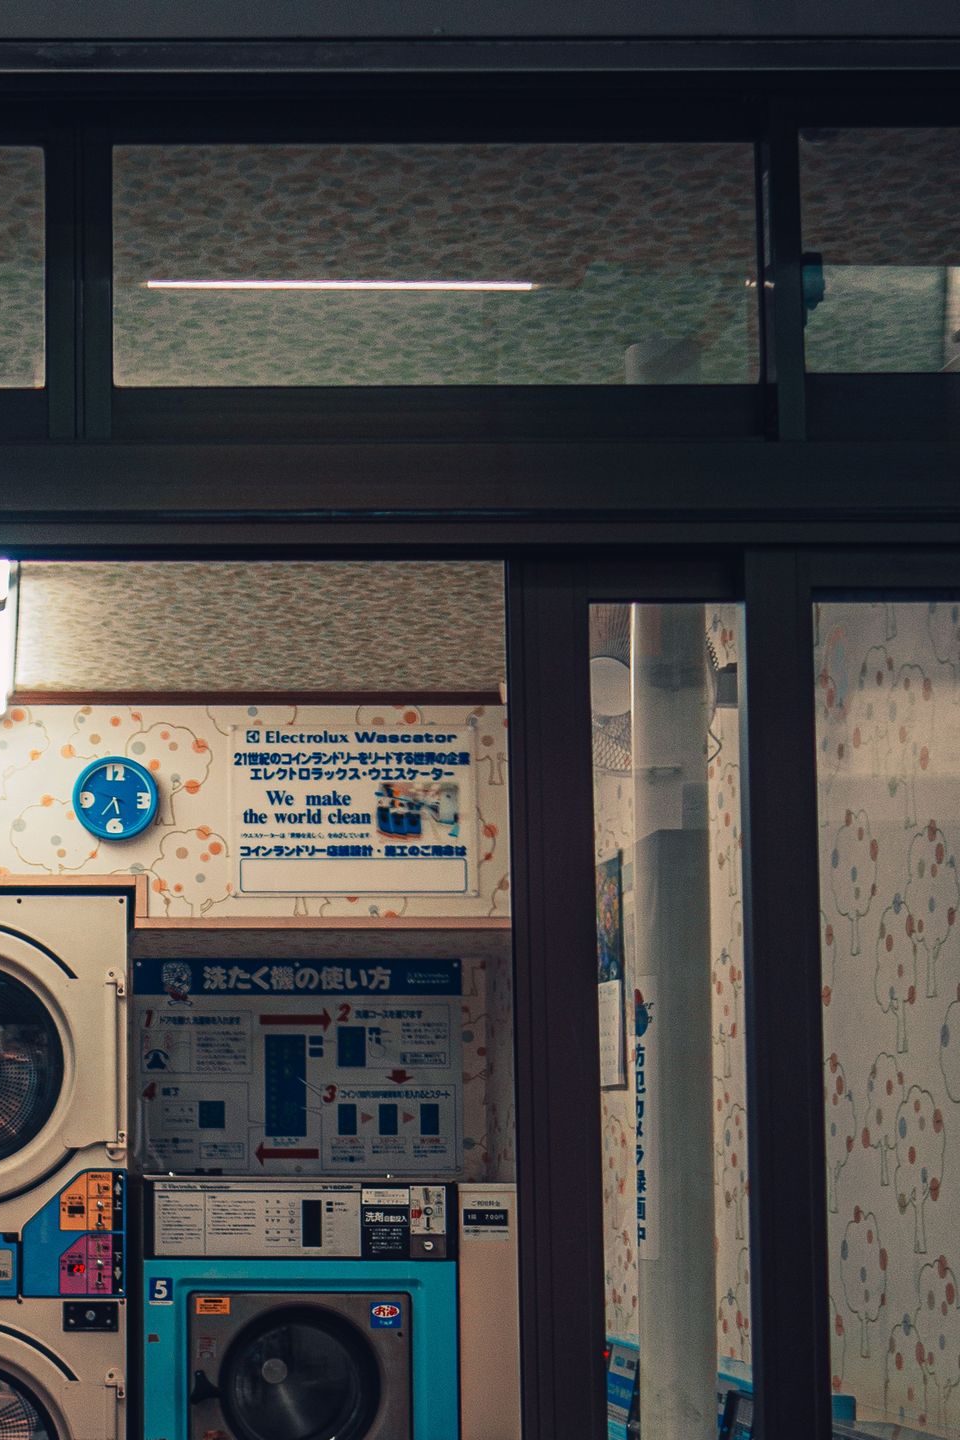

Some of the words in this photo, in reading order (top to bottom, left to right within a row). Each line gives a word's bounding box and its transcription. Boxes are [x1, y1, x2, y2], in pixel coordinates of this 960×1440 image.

[265, 730, 349, 744] Electrolux
[354, 731, 457, 744] Wascator
[106, 764, 126, 781] 12
[80, 791, 96, 809] 9
[136, 791, 151, 809] 3
[266, 790, 294, 806] We
[306, 790, 351, 806] make
[243, 808, 267, 824] the
[275, 808, 322, 824] world
[328, 808, 371, 824] clean
[106, 817, 124, 834] 6
[203, 966, 392, 991] 洗たく機の使い方
[144, 1009, 153, 1028] 1
[336, 1003, 351, 1022] 2
[142, 1081, 156, 1100] 4
[322, 1084, 337, 1103] 3
[73, 1264, 85, 1273] 29
[154, 1279, 168, 1299] 5
